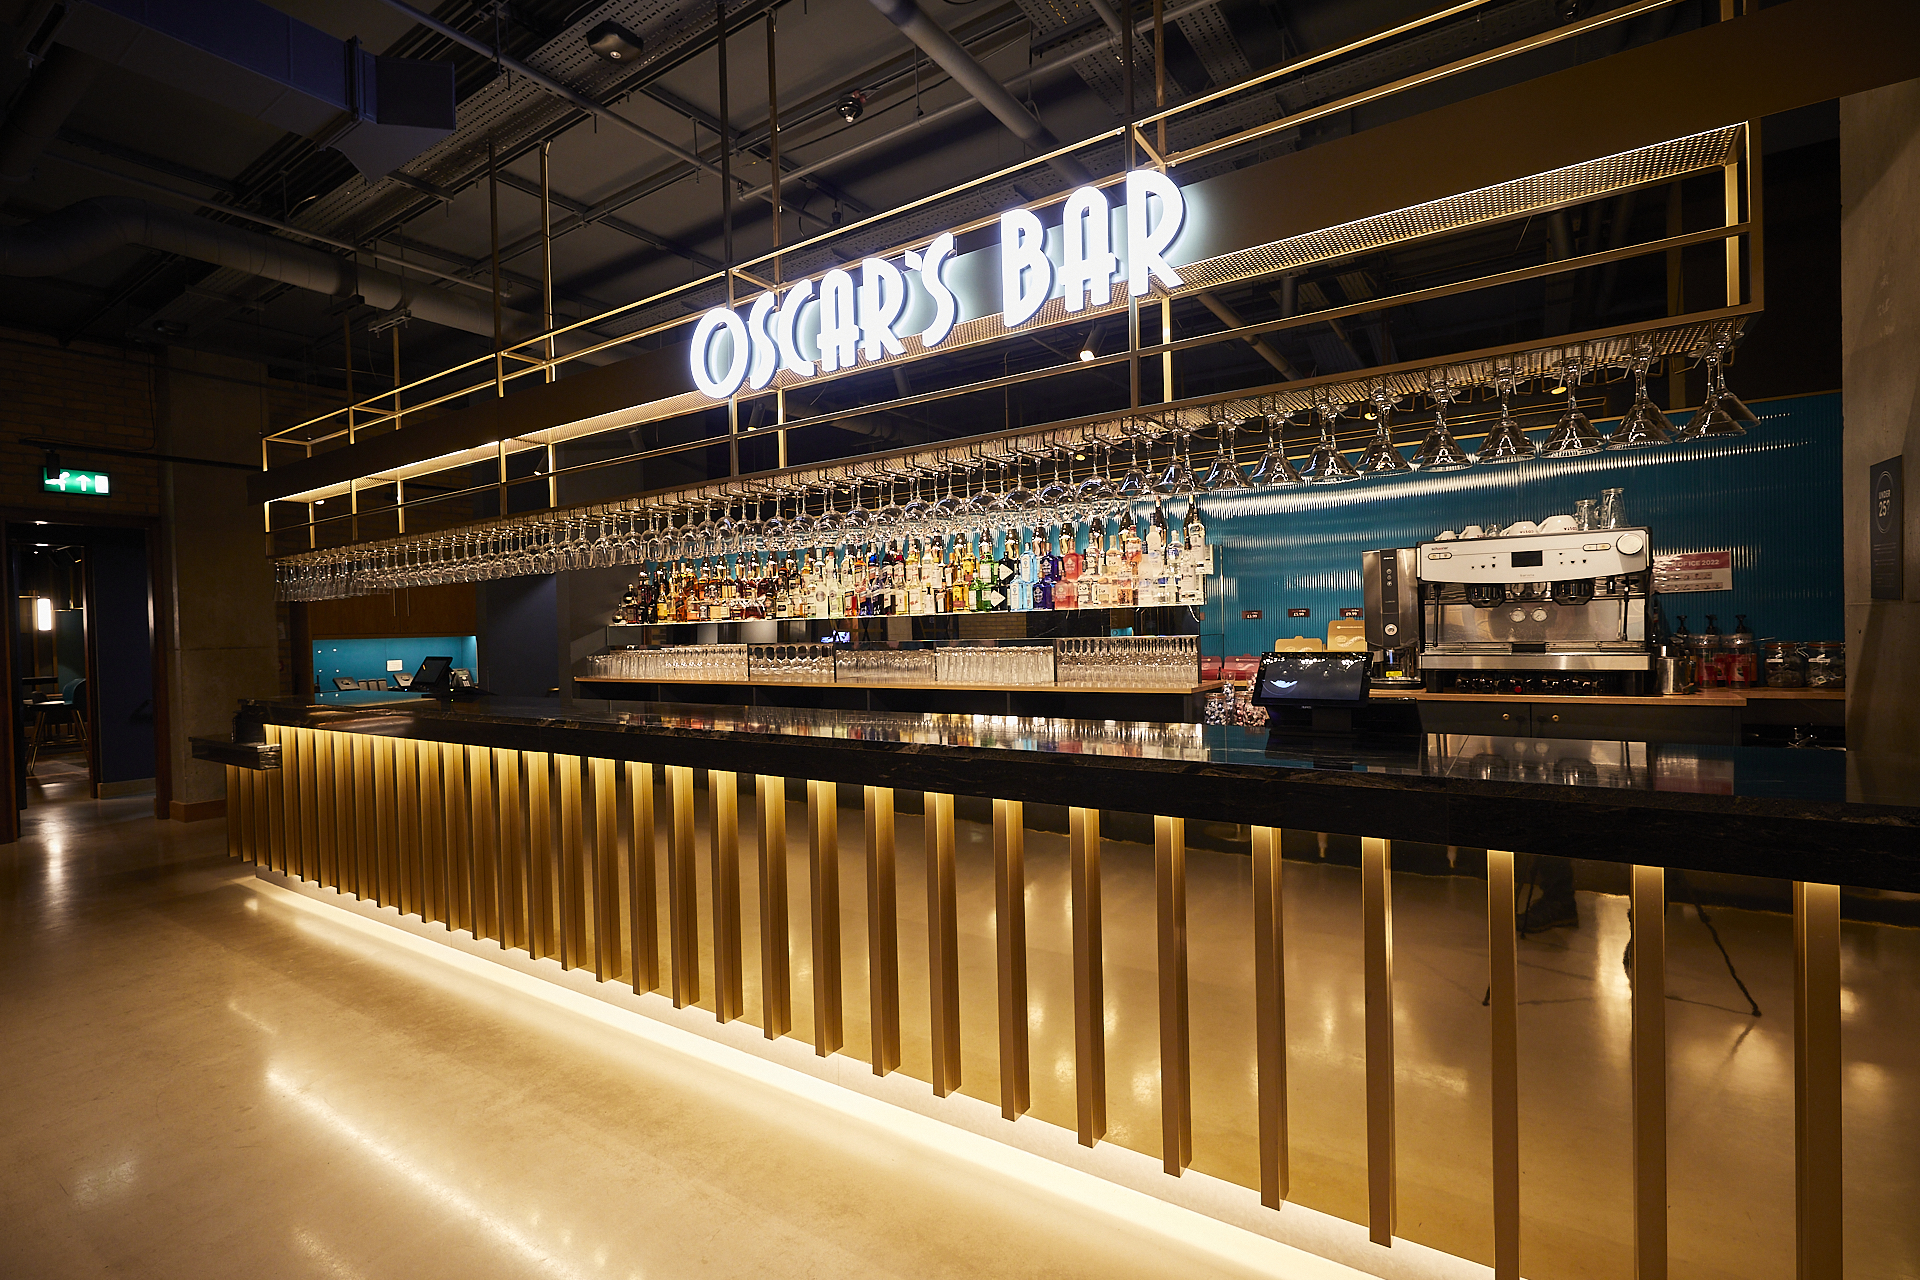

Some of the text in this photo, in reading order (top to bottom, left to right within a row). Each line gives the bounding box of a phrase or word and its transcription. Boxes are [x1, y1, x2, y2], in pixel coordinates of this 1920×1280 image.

[690, 169, 1186, 400] OSCAR'S BAR
[1878, 499, 1890, 517] 25?
